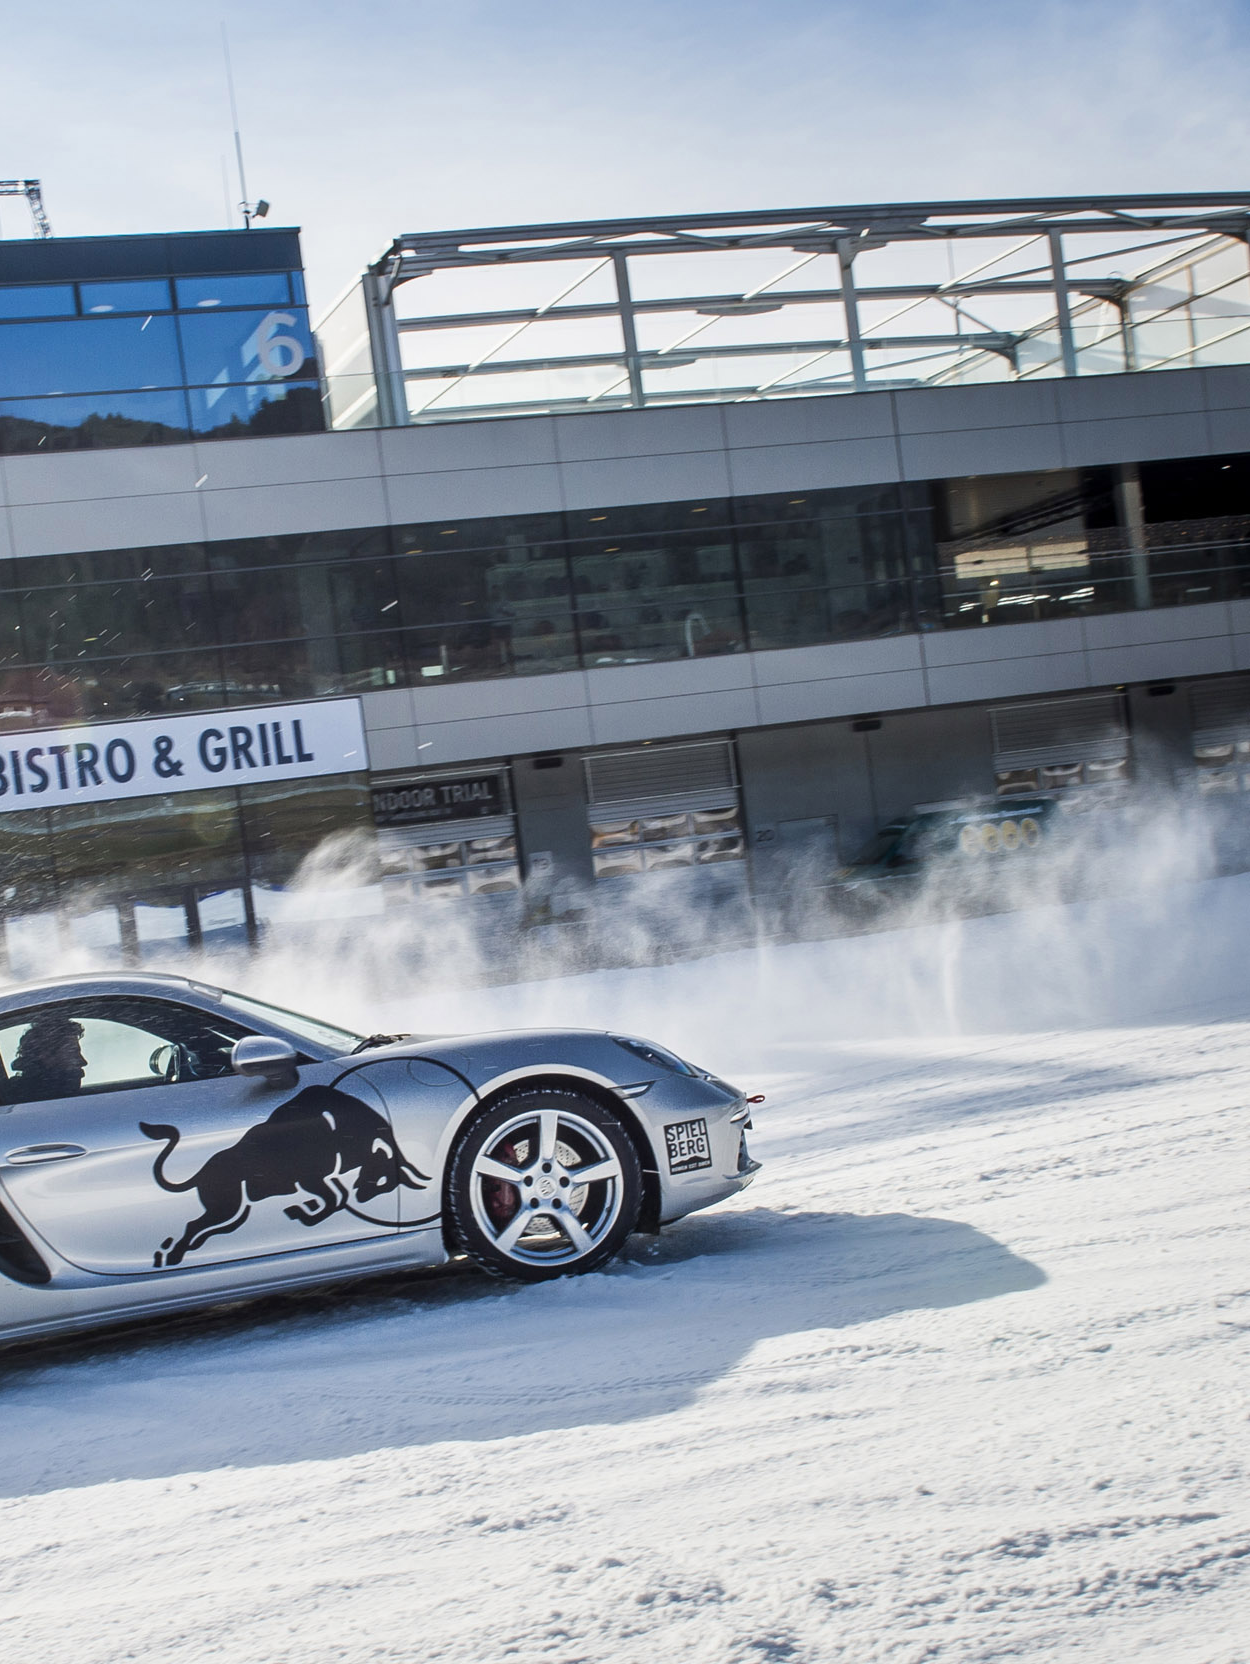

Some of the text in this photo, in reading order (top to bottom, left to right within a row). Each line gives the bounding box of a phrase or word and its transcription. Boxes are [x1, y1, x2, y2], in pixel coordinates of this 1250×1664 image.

[258, 312, 304, 376] 6
[153, 735, 184, 778] &
[198, 719, 314, 773] GRILL
[372, 781, 493, 812] NDOOR TRIAL
[666, 1121, 706, 1142] SPIEL
[669, 1137, 706, 1159] BERG
